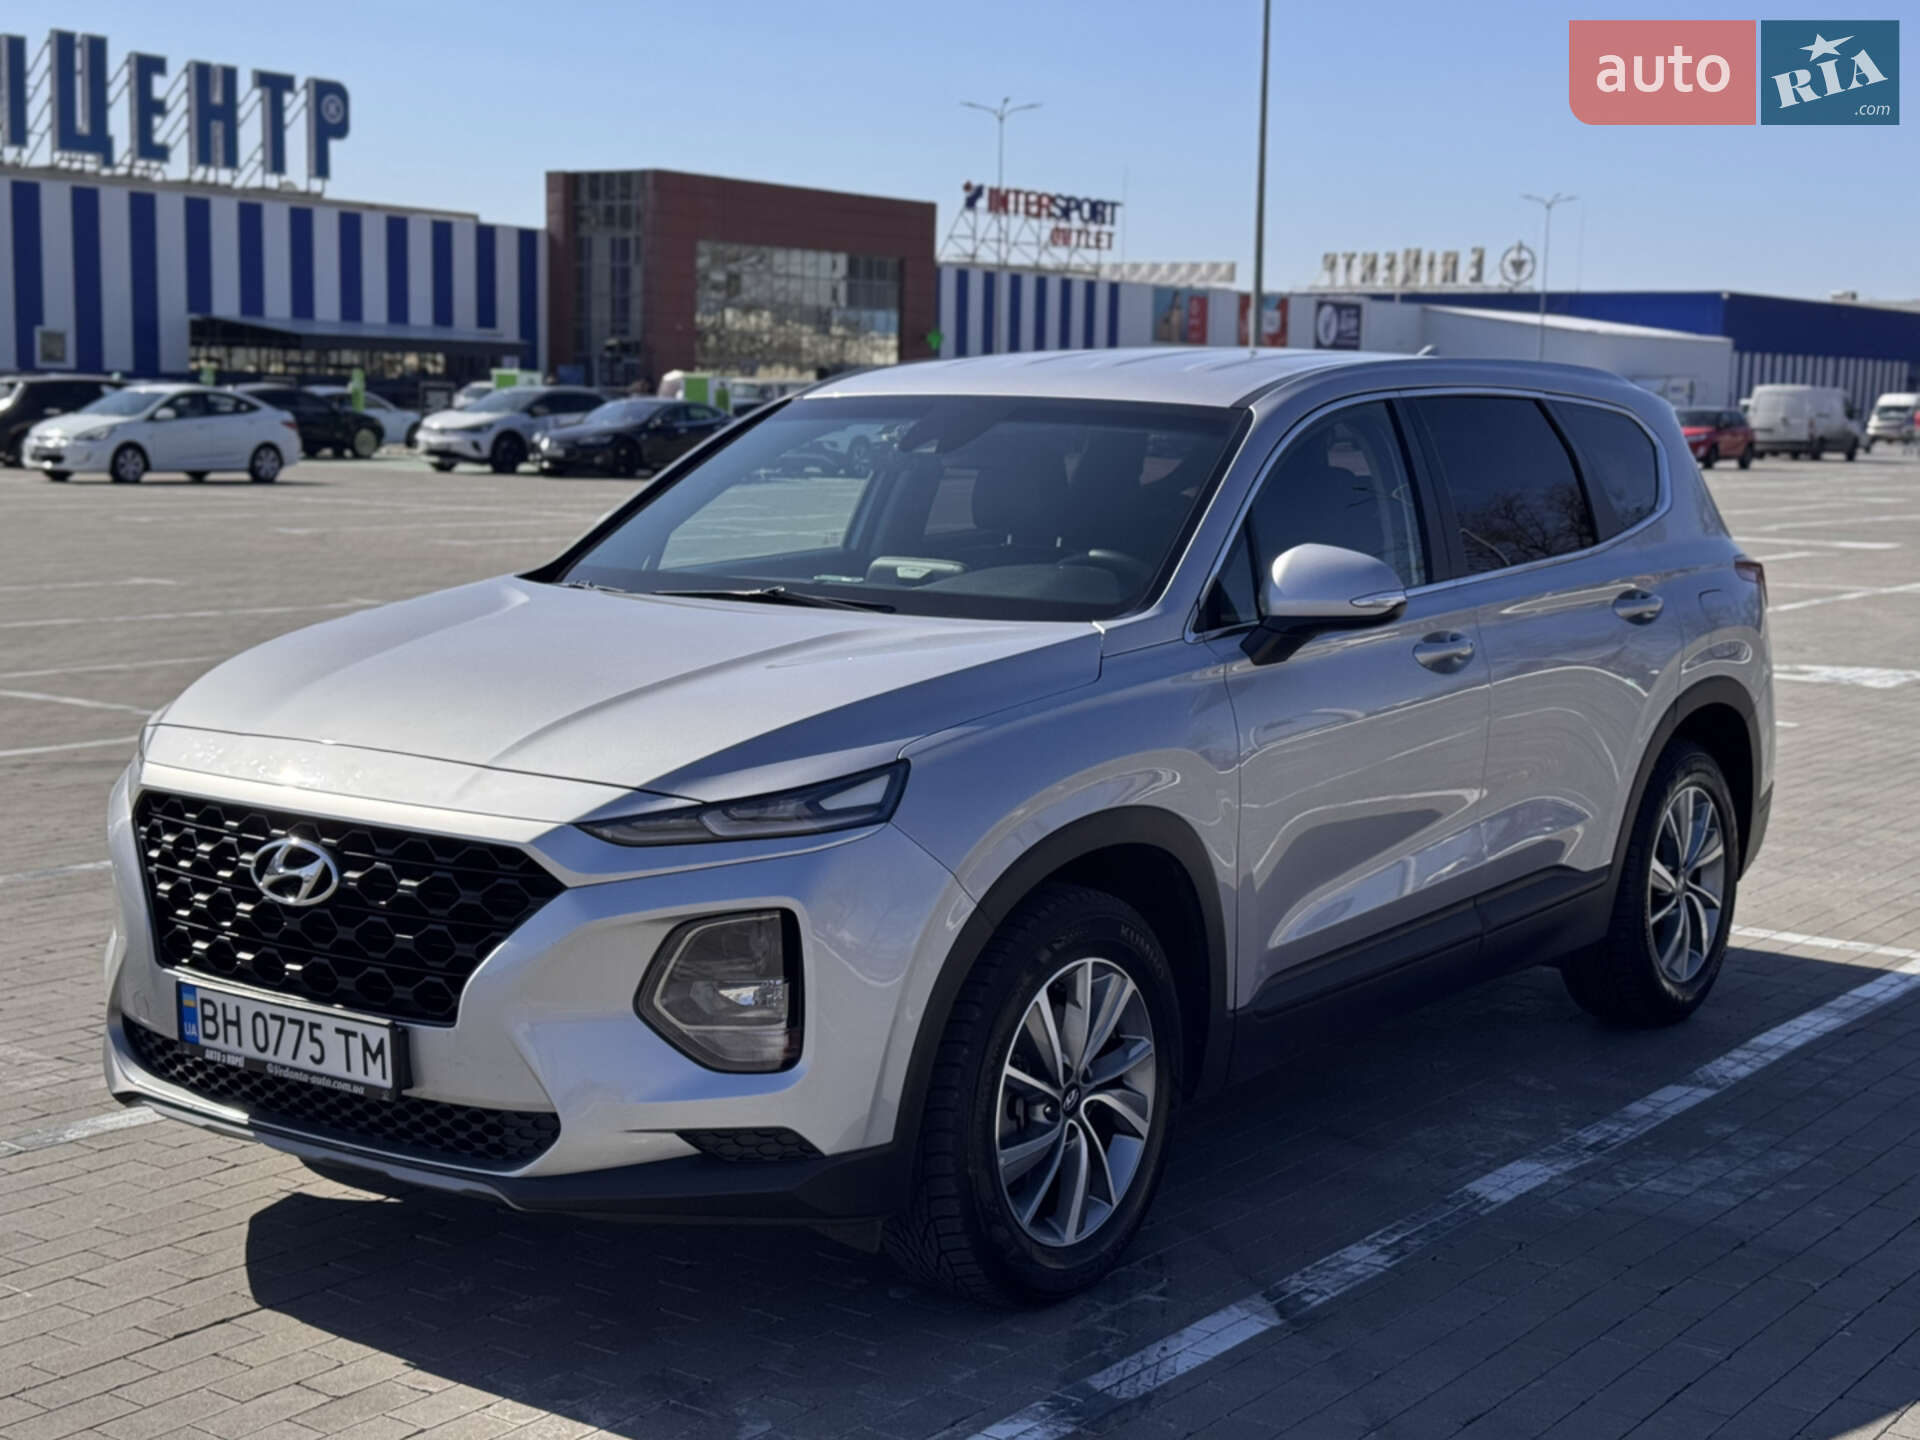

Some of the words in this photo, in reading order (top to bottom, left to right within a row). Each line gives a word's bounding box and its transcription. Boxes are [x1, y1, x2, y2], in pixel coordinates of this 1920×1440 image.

[987, 187, 1123, 226] INTERSPORT
[1051, 226, 1114, 250] OUTLET
[184, 1022, 198, 1036] UA
[200, 998, 242, 1048] BH
[252, 1011, 326, 1066] 0775
[335, 1028, 387, 1081] TM
